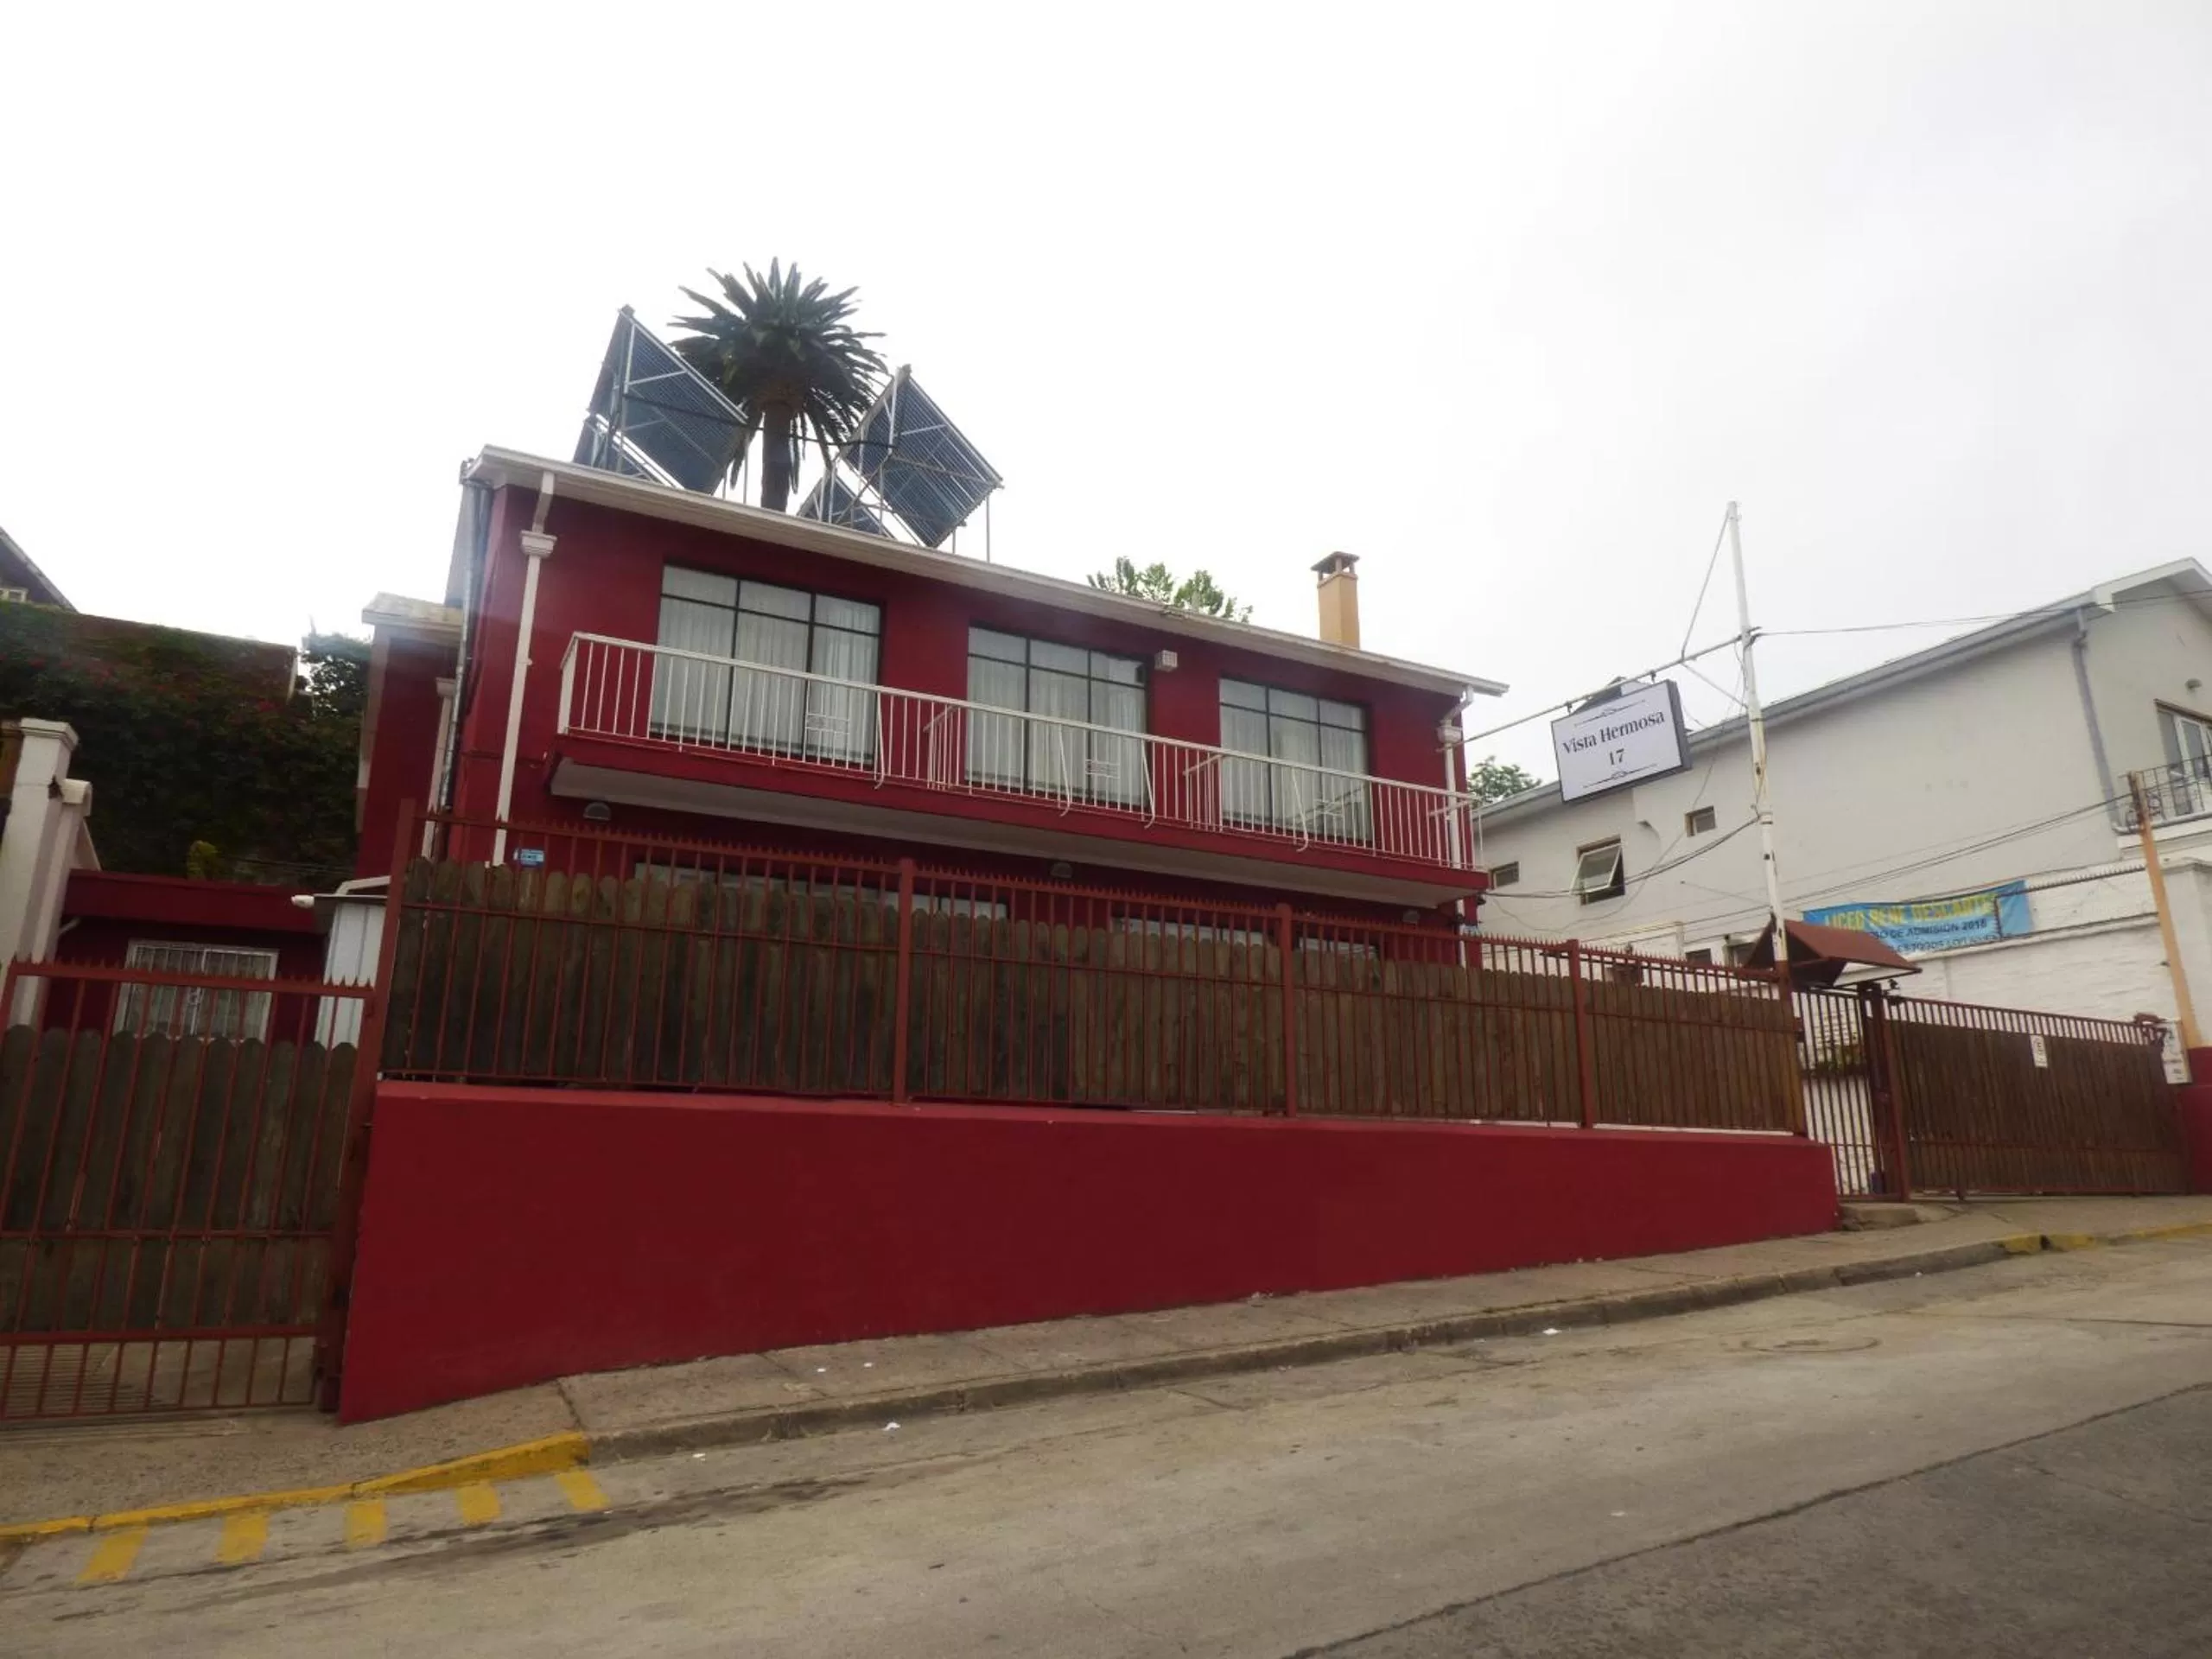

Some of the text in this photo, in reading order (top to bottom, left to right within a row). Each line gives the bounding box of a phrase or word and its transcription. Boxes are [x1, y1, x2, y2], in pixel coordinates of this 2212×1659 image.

[1562, 711, 1665, 754] Vista Hermosa
[1609, 748, 1625, 766] 17
